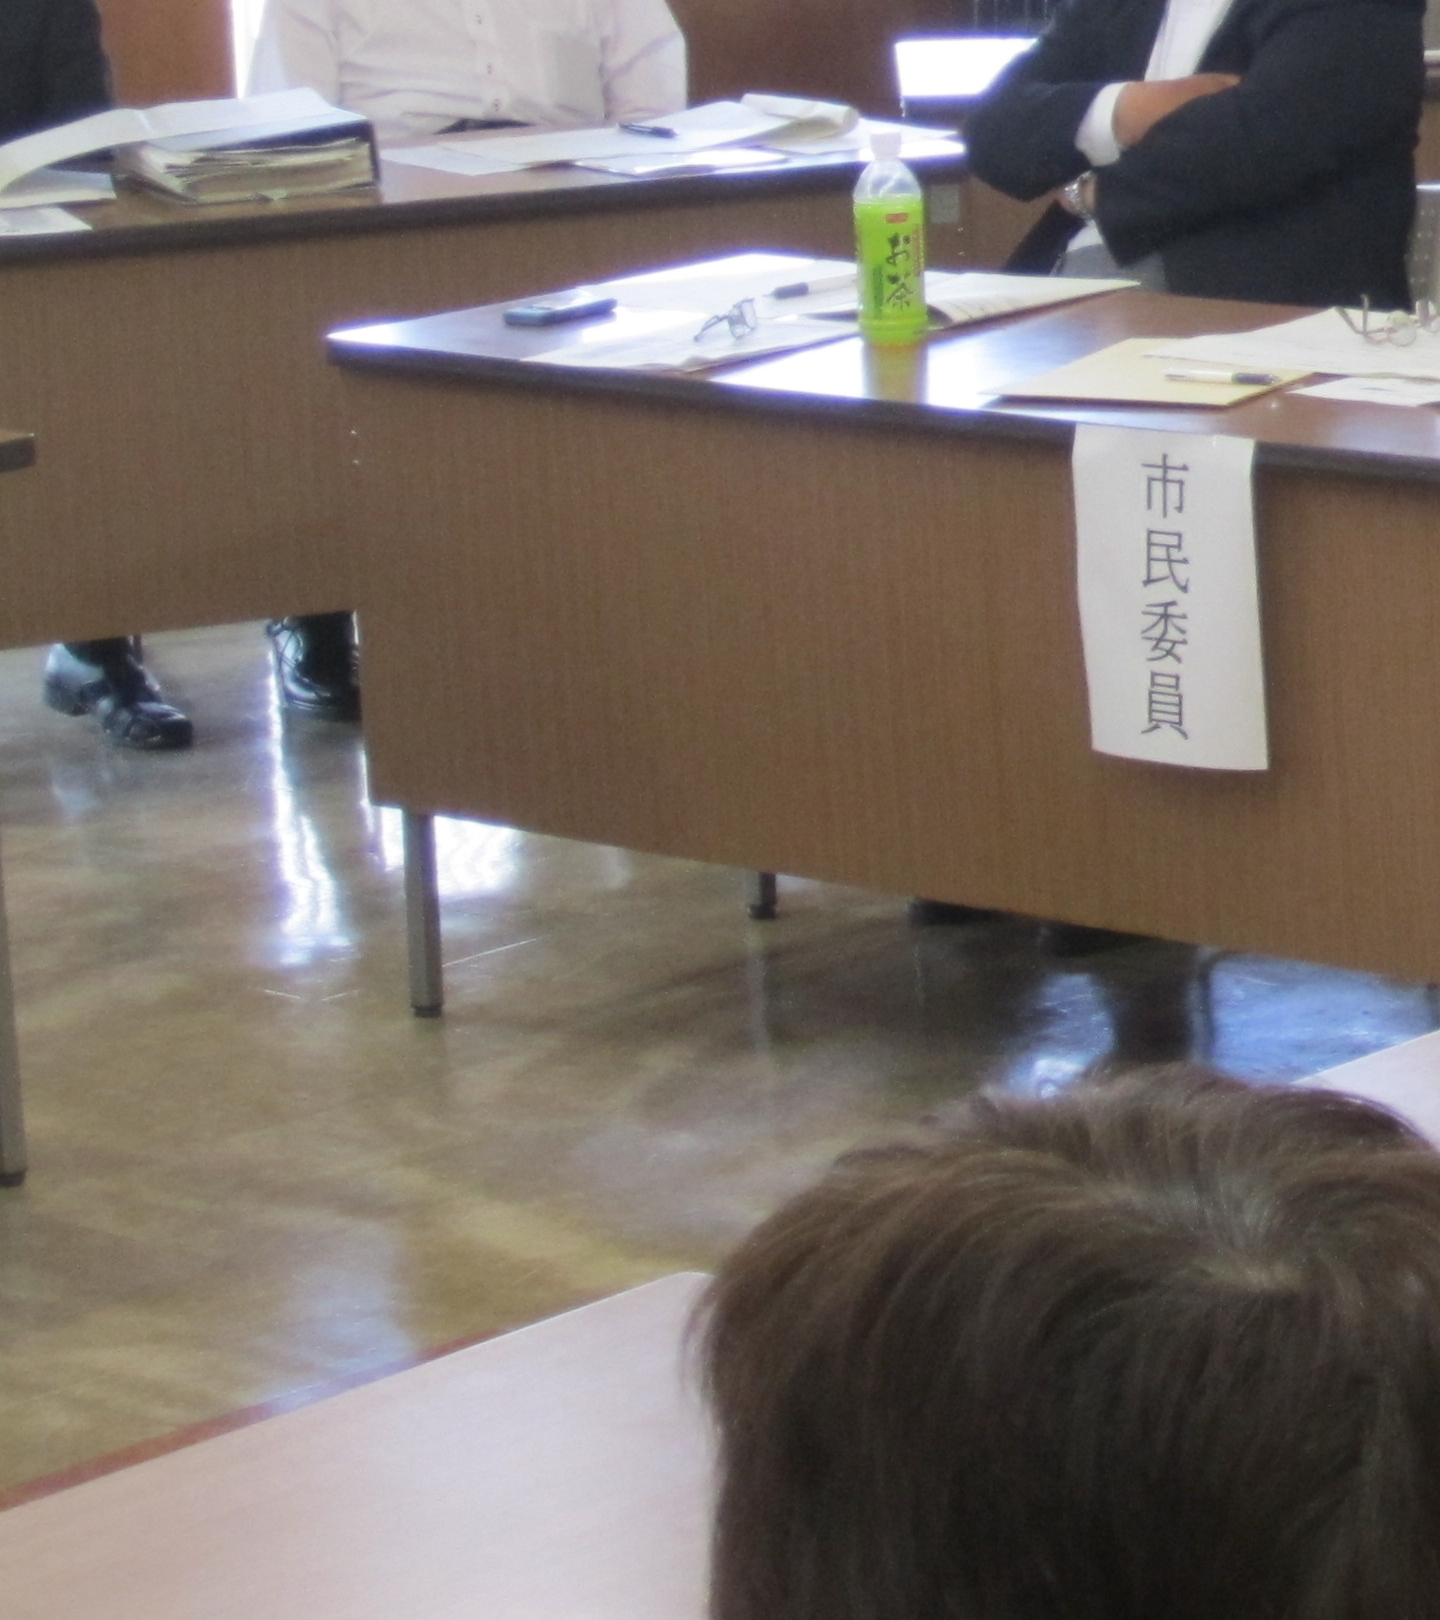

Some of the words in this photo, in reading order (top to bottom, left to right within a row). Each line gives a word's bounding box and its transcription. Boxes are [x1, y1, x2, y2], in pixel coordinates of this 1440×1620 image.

[884, 231, 915, 312] お茶
[1140, 453, 1189, 741] 市民委員
